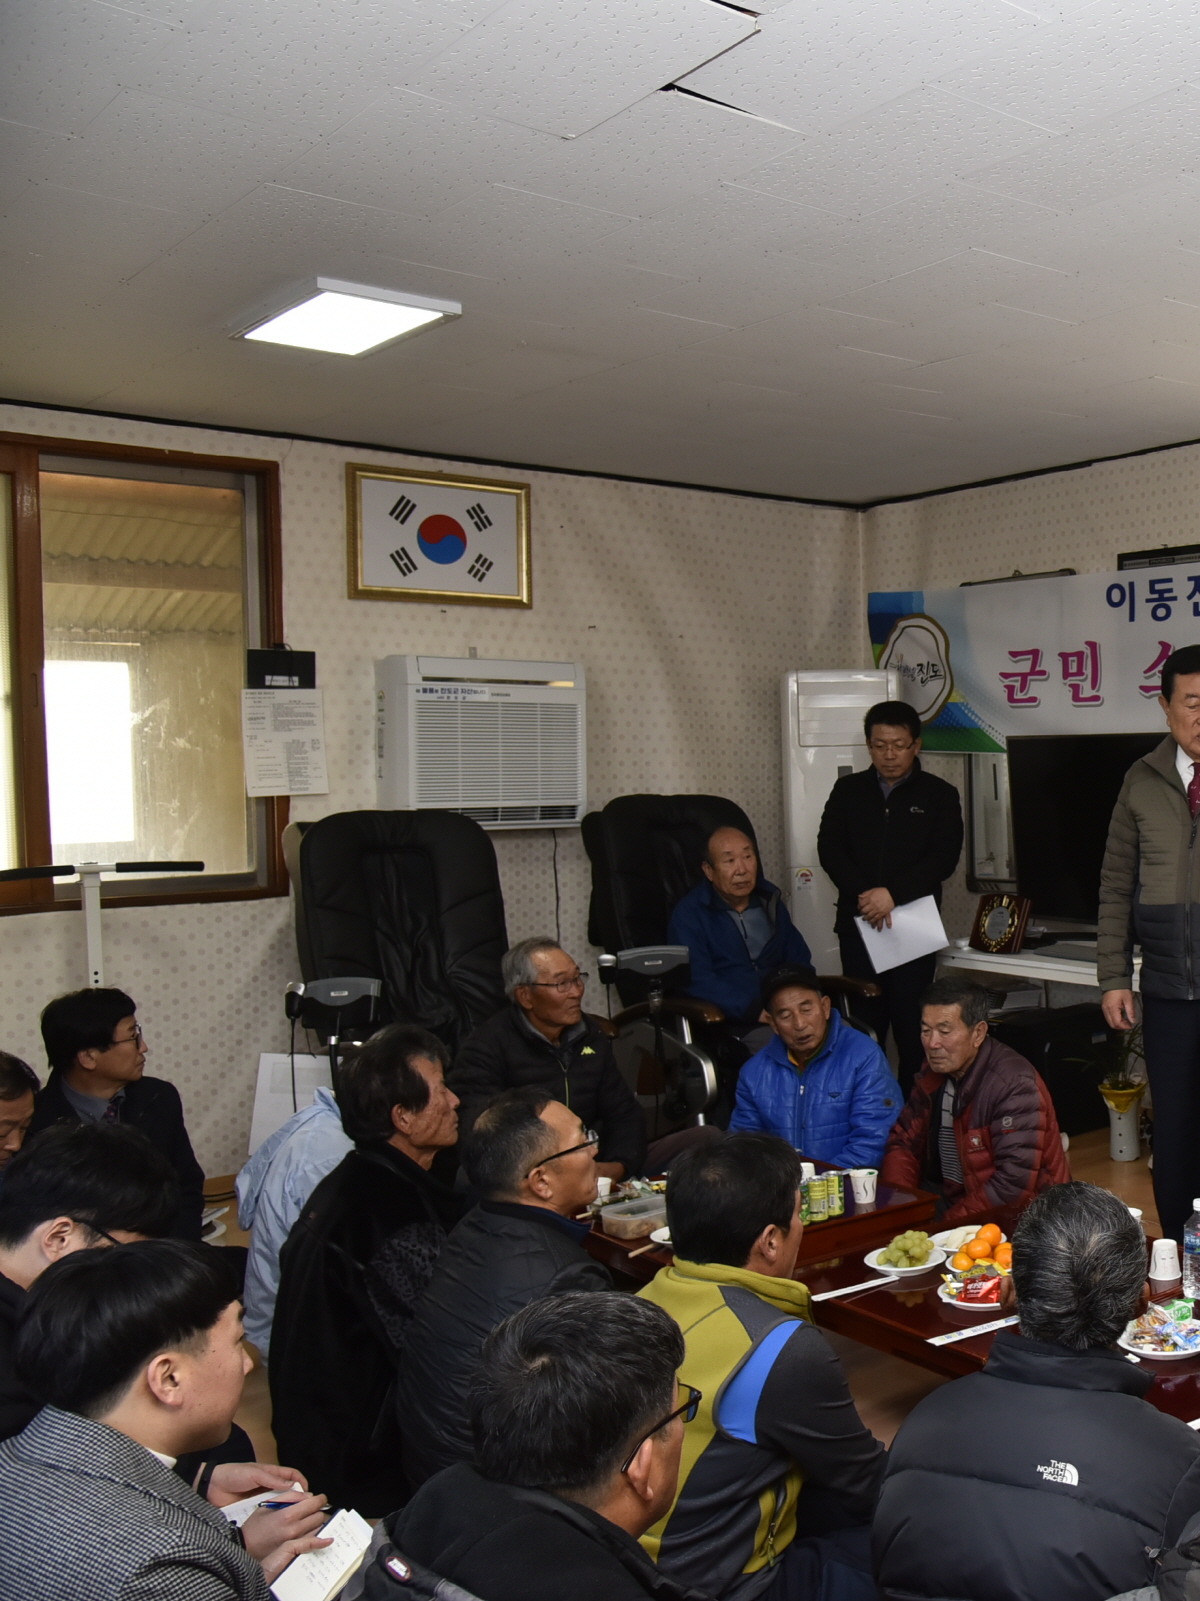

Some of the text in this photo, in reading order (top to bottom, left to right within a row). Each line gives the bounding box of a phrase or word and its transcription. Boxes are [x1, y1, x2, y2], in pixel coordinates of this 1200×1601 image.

[998, 640, 1103, 705] 군민
[1036, 1464, 1066, 1478] NORTH
[1050, 1460, 1067, 1470] THE
[1042, 1472, 1064, 1483] FACE
